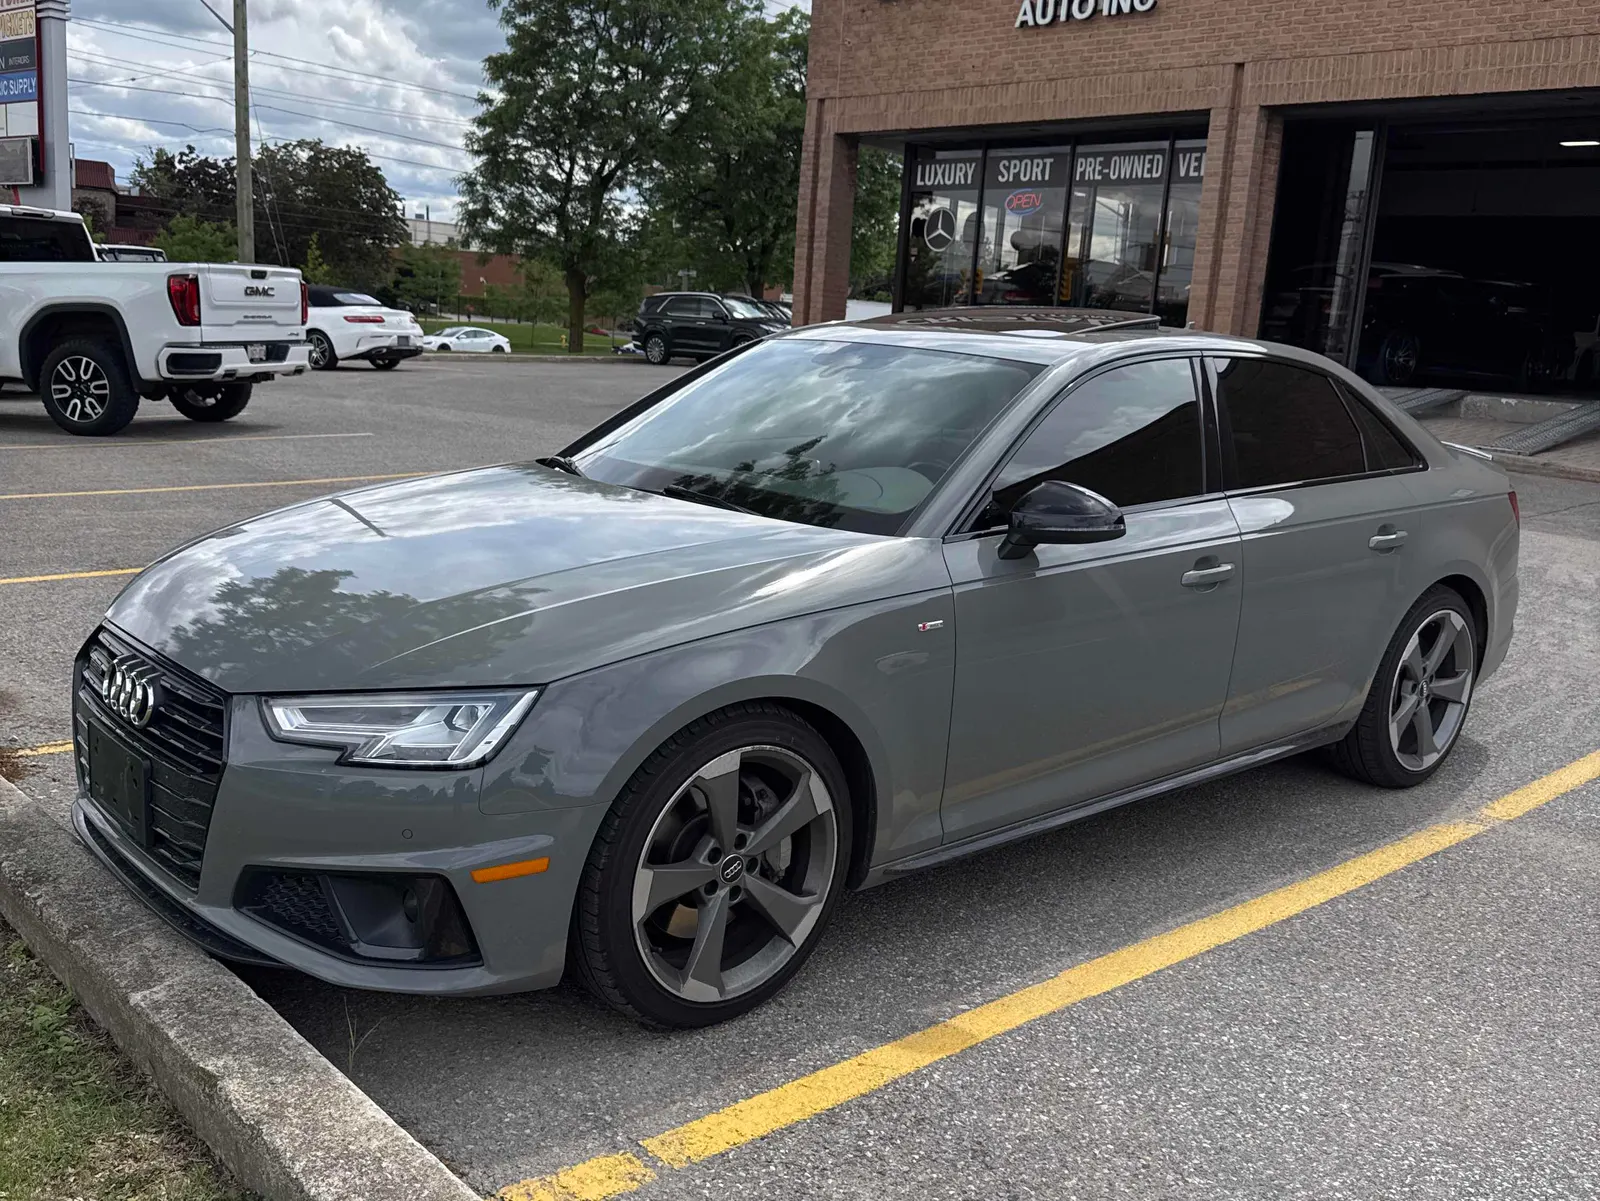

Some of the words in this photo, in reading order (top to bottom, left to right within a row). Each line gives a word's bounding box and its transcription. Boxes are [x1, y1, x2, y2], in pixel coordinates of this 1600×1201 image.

[1014, 0, 1096, 27] AUTO
[10, 77, 37, 95] SUPPLY
[916, 162, 976, 187] LUXURY
[998, 158, 1053, 183] SPORT
[1076, 154, 1163, 181] PRE-OWNED
[1006, 192, 1042, 209] OPEN
[244, 286, 275, 297] GMC
